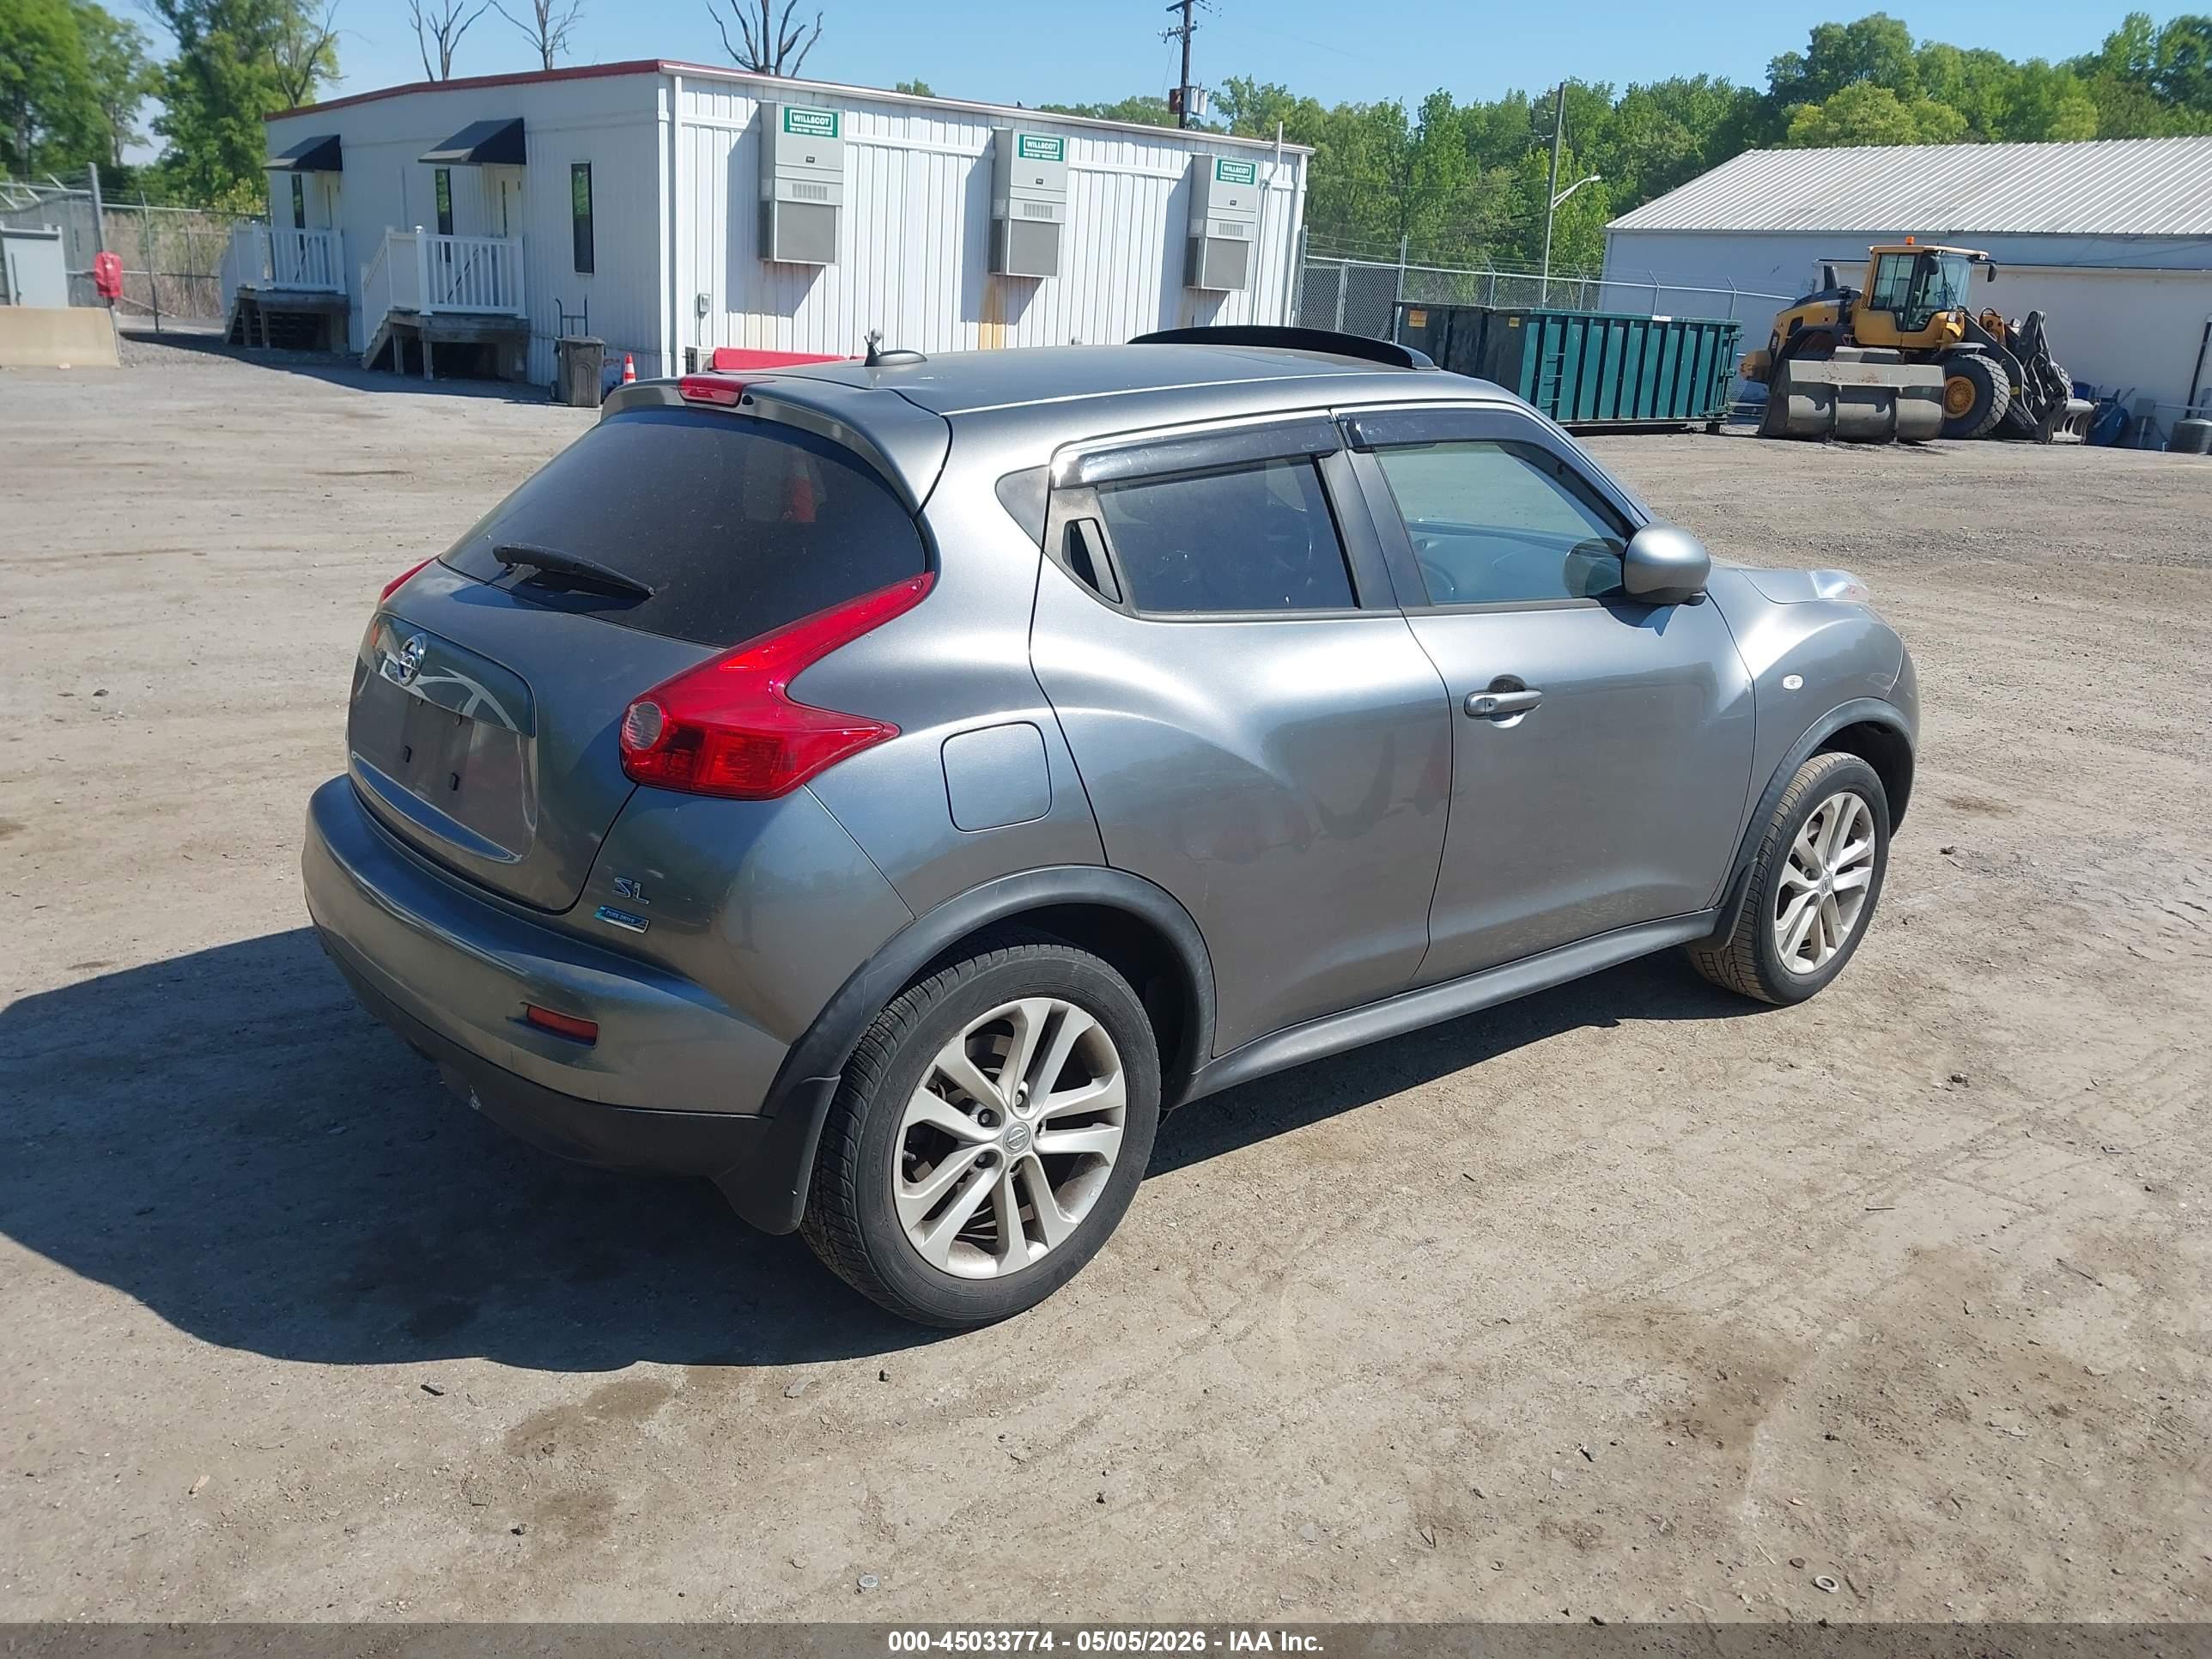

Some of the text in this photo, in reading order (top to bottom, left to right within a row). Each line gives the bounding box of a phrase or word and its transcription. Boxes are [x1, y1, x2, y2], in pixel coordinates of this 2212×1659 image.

[793, 113, 830, 126] WILLSCOT
[1026, 140, 1057, 151] WILLSCOT
[1223, 164, 1250, 175] WILLSCOT
[611, 877, 650, 905] SL
